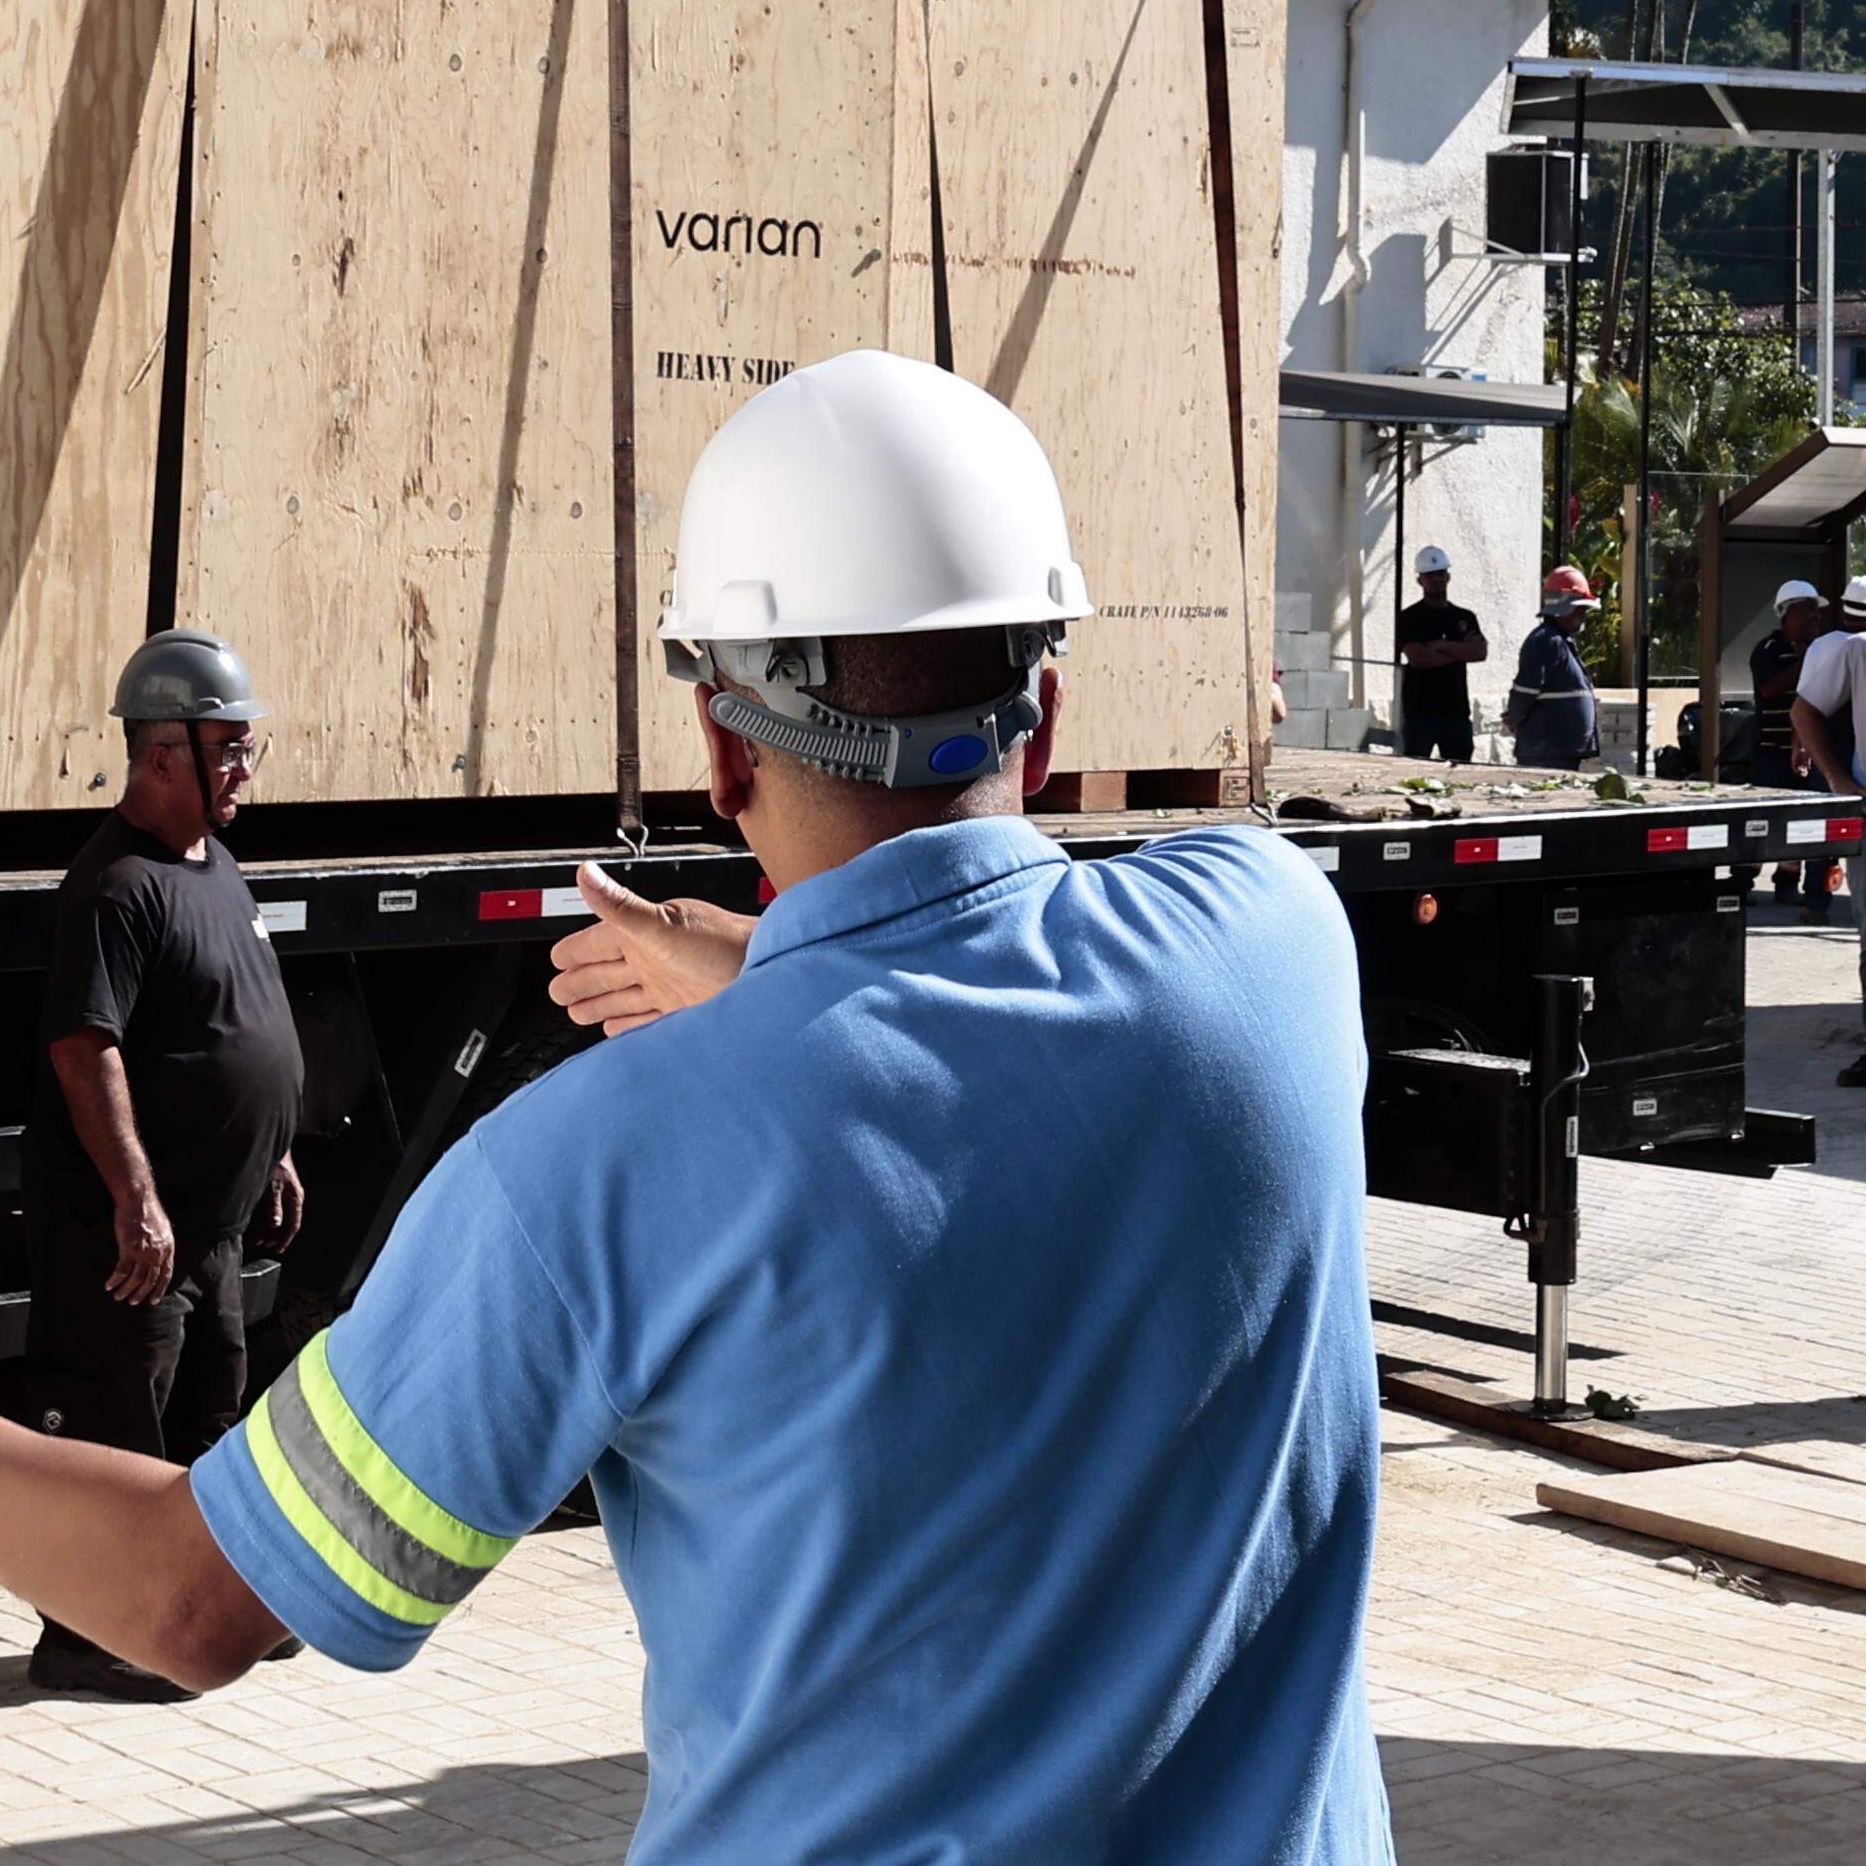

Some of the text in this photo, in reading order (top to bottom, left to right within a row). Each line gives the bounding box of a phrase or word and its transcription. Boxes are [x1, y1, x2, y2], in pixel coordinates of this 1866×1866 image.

[655, 209, 821, 259] varian
[656, 350, 736, 383] HEAVY
[1098, 605, 1137, 619] CRATE
[1140, 606, 1160, 619] P/N
